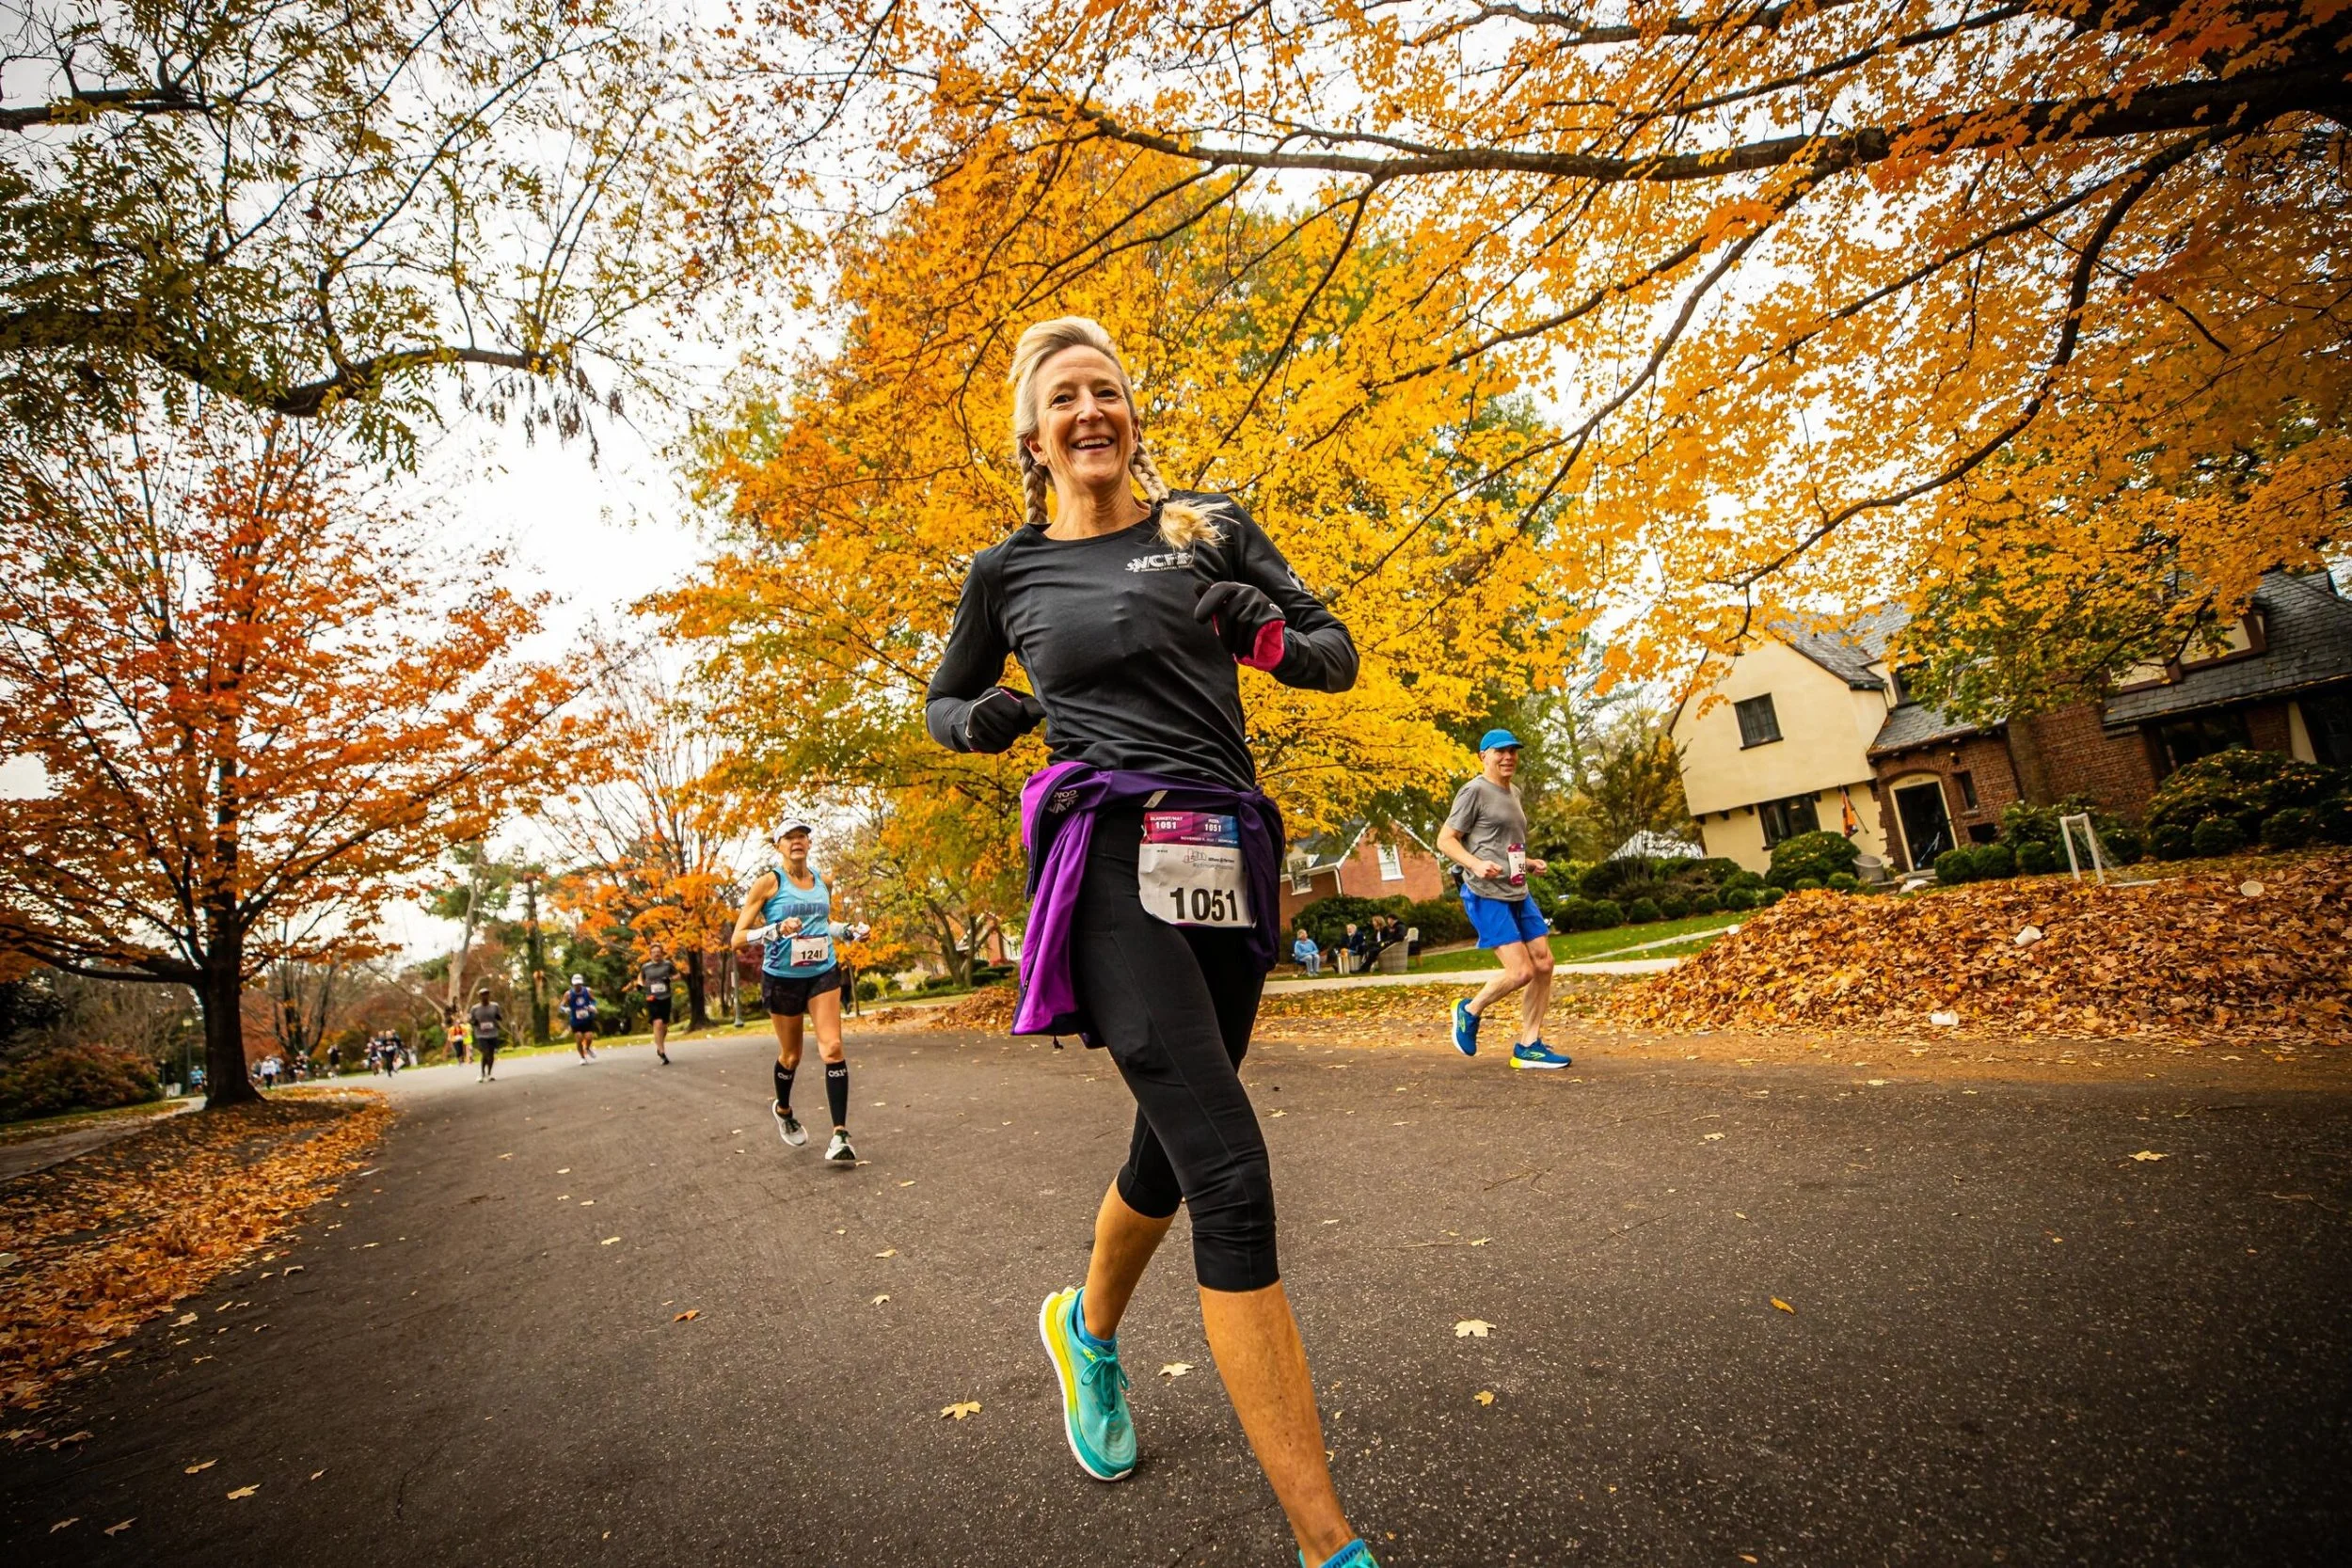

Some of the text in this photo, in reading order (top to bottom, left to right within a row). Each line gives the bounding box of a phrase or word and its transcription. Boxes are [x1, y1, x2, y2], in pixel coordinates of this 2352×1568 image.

[1155, 820, 1177, 829] 1051
[1205, 823, 1221, 832] 1051
[1169, 887, 1238, 922] 1051
[801, 949, 823, 959] 1241
